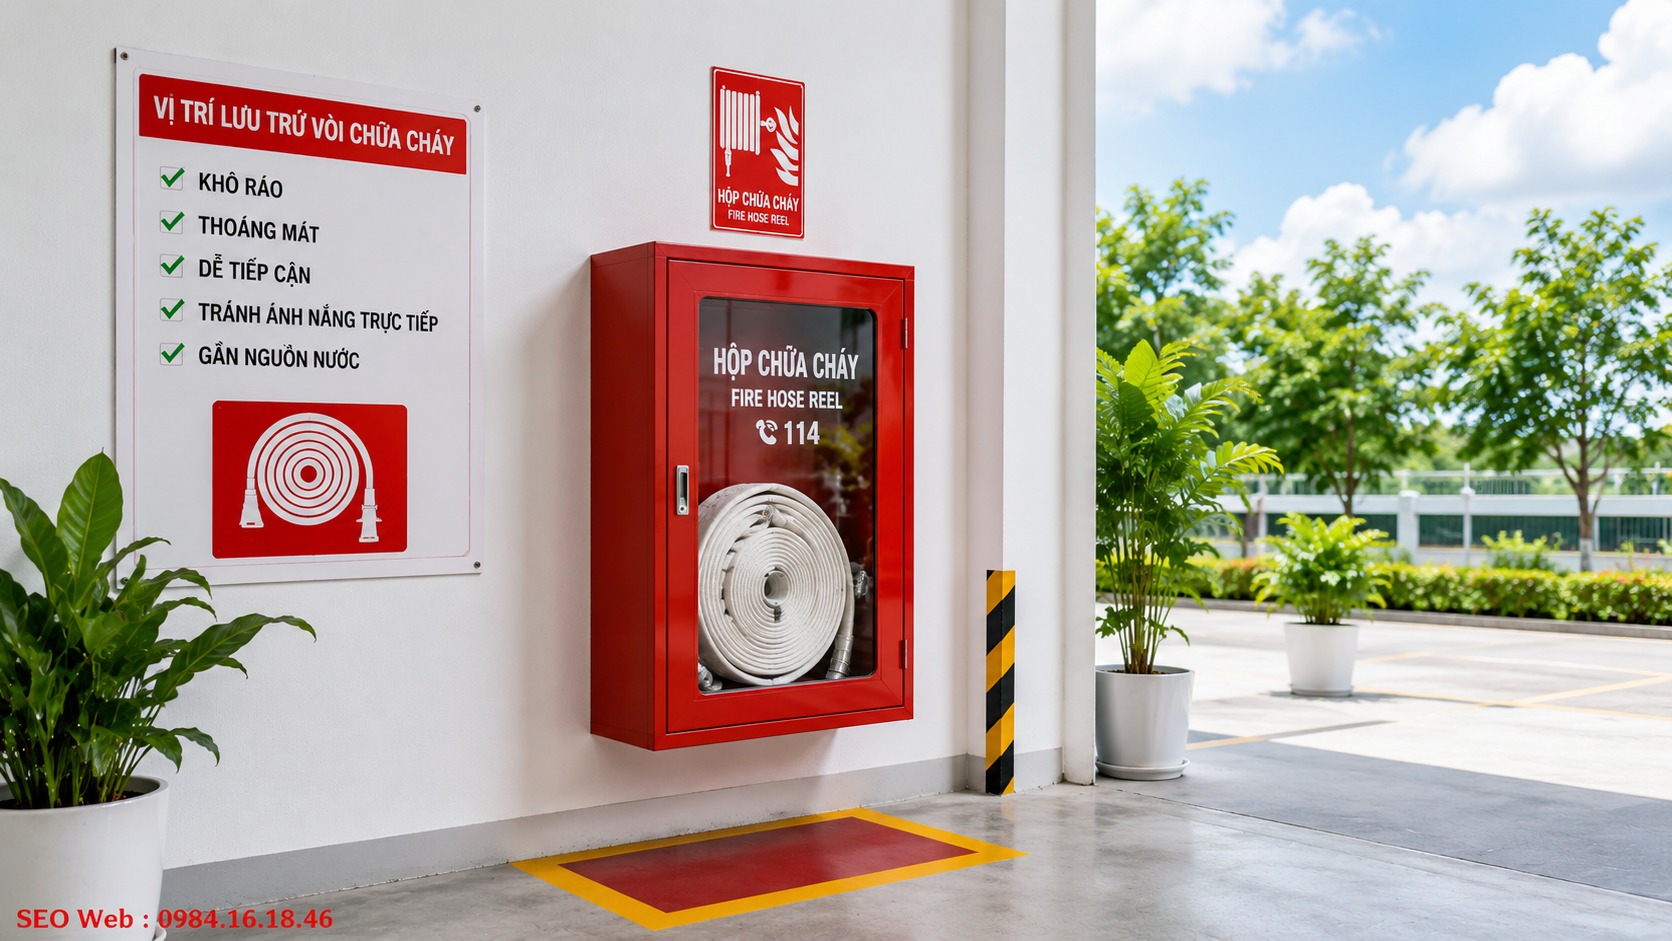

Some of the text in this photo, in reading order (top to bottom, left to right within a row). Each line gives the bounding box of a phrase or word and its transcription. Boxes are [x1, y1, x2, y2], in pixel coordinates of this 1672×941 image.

[180, 97, 215, 126] TRÍ
[220, 105, 261, 132] LƯU
[311, 113, 344, 142] VÒI
[350, 121, 402, 150] CHỮA
[406, 129, 455, 156] CHÁY
[198, 171, 283, 198] KHÔ RÁO
[772, 193, 799, 212] CHÁY
[198, 215, 320, 243] THOÁNG MÁT
[728, 209, 790, 226] FIRE HOSE REEL
[229, 257, 269, 281] TIẾP
[274, 261, 311, 288] CẬN
[198, 300, 439, 334] TRÁNH ÁNH NẮNG TRỰC TIẾP
[313, 347, 360, 370] NƯỚC
[713, 341, 859, 381] HỘP CHỮA CHÁY
[731, 388, 843, 410] FIRE HOSE REEL
[783, 420, 820, 445] 114
